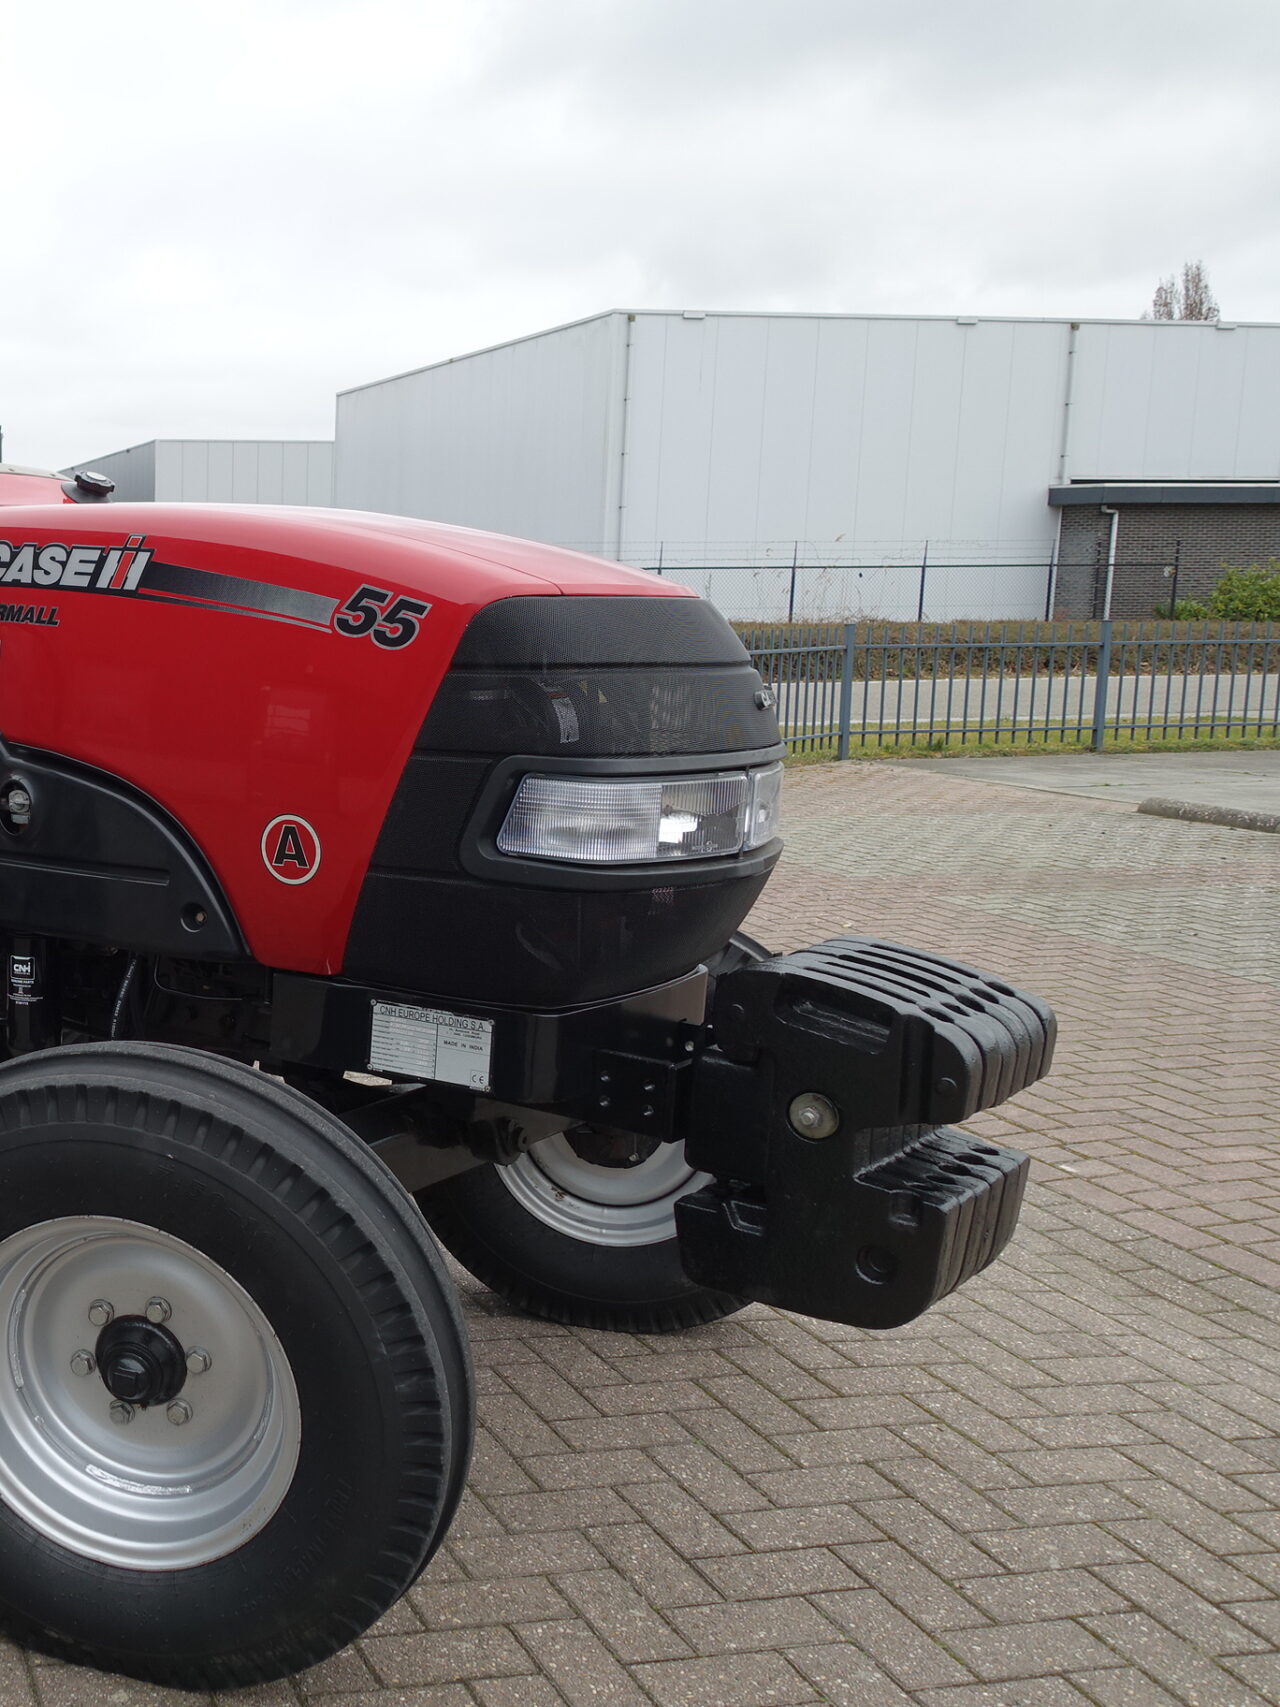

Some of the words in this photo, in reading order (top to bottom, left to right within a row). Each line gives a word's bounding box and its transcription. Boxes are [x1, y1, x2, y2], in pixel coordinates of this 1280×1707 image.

[334, 584, 433, 650] 55
[272, 824, 310, 869] A
[380, 1005, 397, 1016] CNH
[399, 1008, 430, 1022] EUROPE
[432, 1014, 469, 1028] HOLDING
[469, 1043, 483, 1051] INDIA
